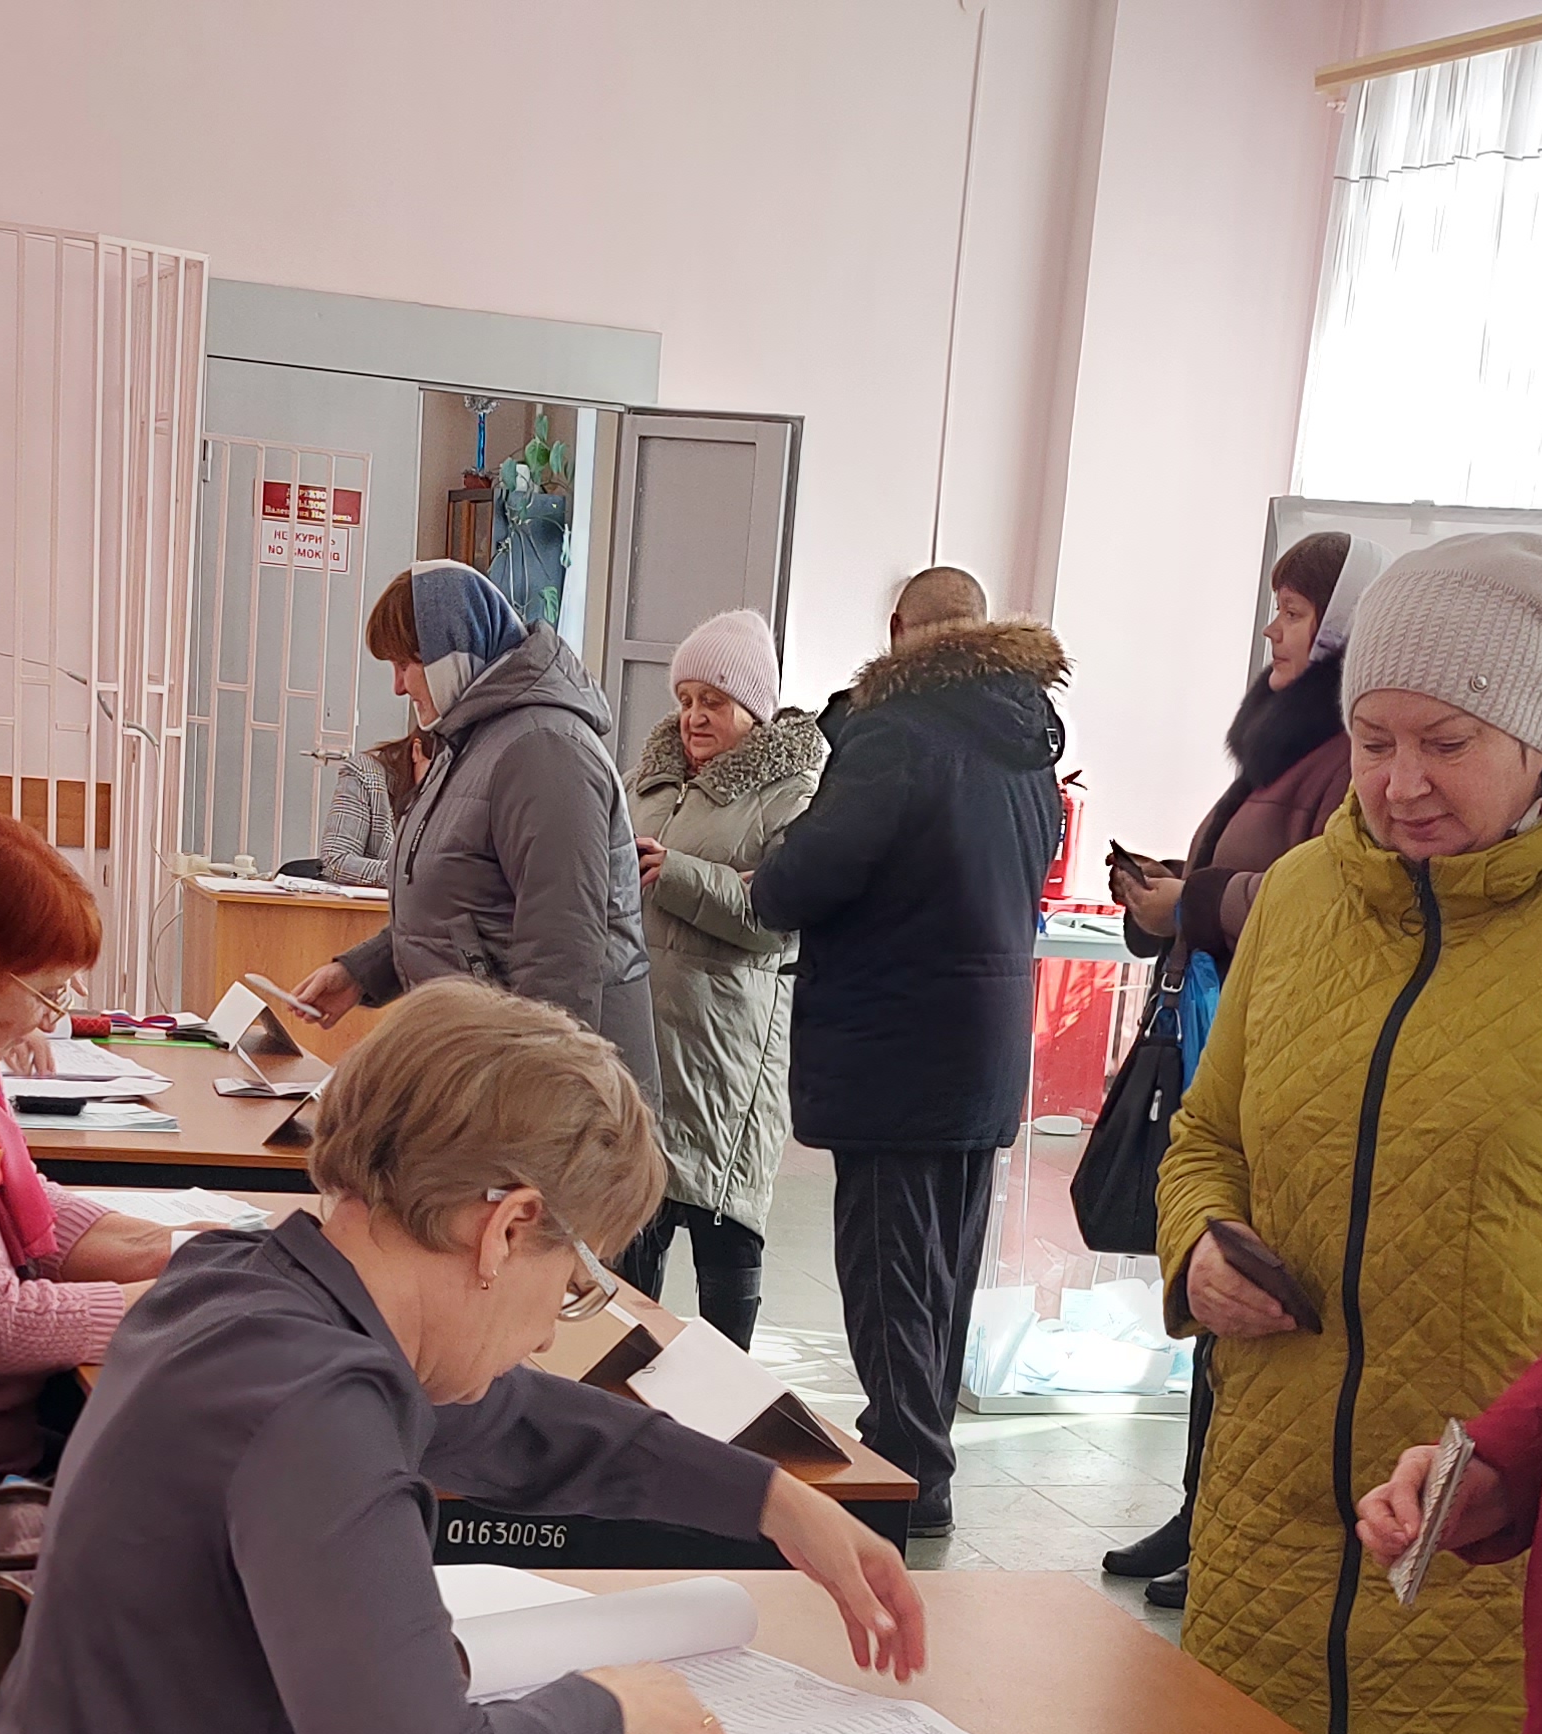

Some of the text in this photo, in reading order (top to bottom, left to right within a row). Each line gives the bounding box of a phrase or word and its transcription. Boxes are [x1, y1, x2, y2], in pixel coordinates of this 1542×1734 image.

[274, 529, 289, 541] НЕ
[268, 544, 284, 555] NO
[447, 1519, 568, 1548] 01630056
